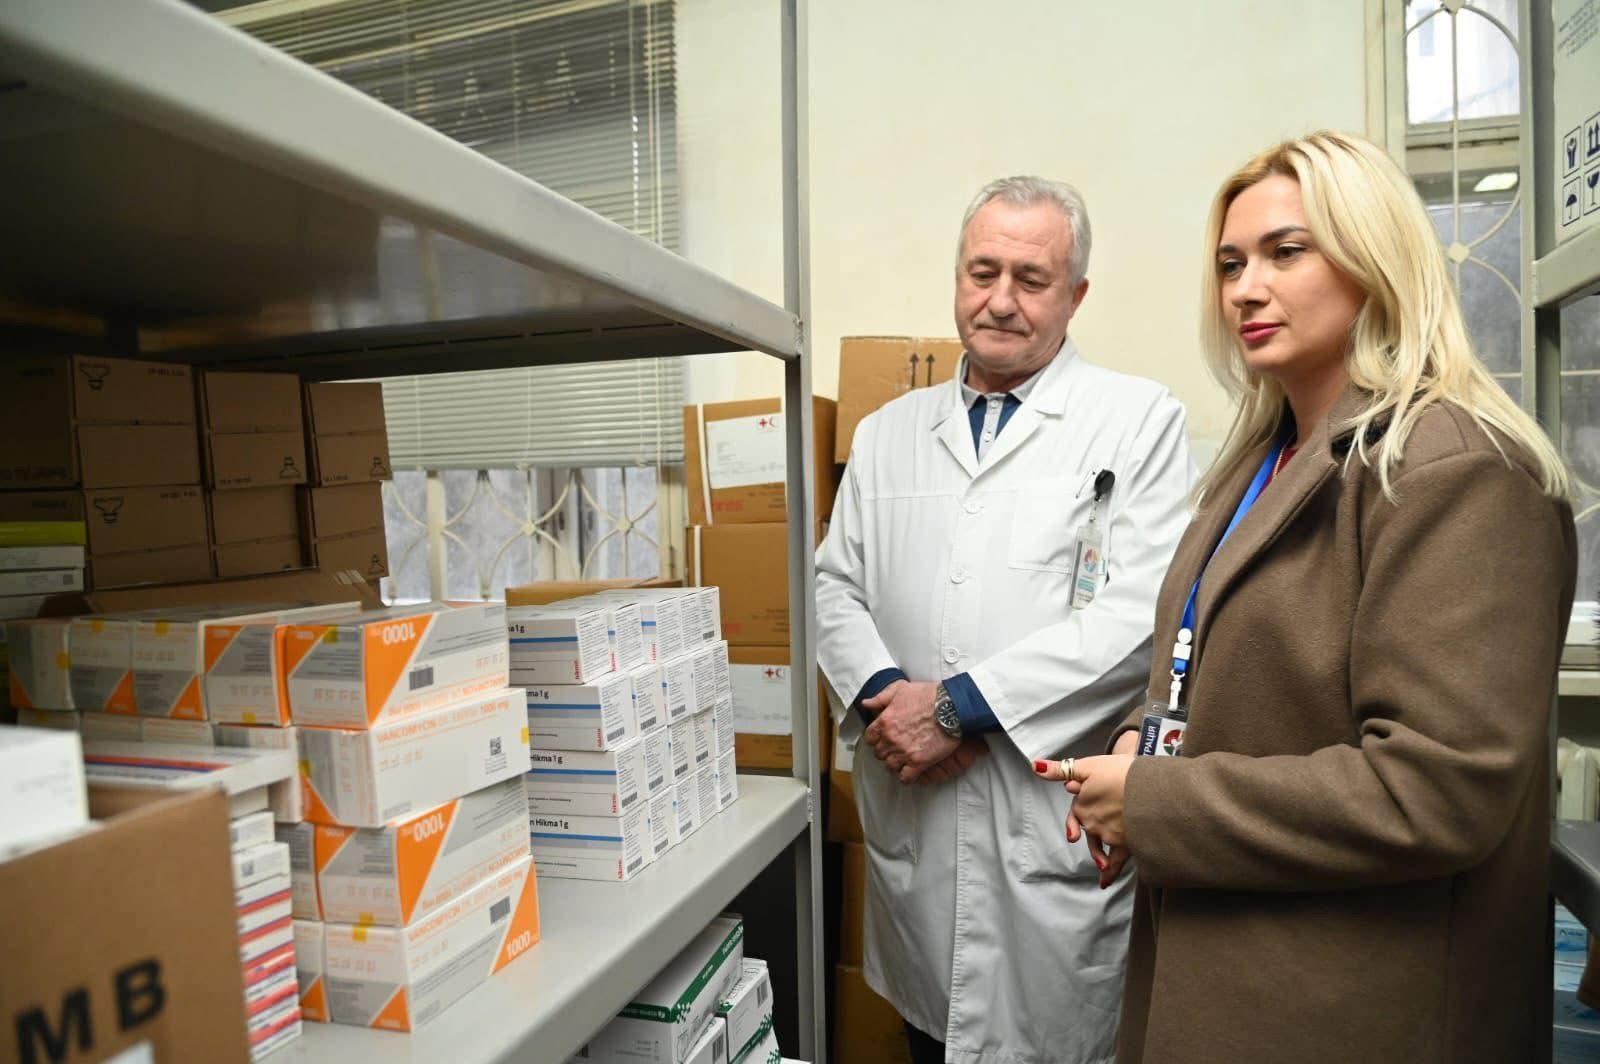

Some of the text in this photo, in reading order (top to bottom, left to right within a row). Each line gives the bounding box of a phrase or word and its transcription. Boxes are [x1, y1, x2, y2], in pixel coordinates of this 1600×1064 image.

[383, 622, 416, 645] 1000
[413, 813, 445, 842] 1000
[535, 818, 559, 828] Hikma
[506, 930, 531, 959] 1000
